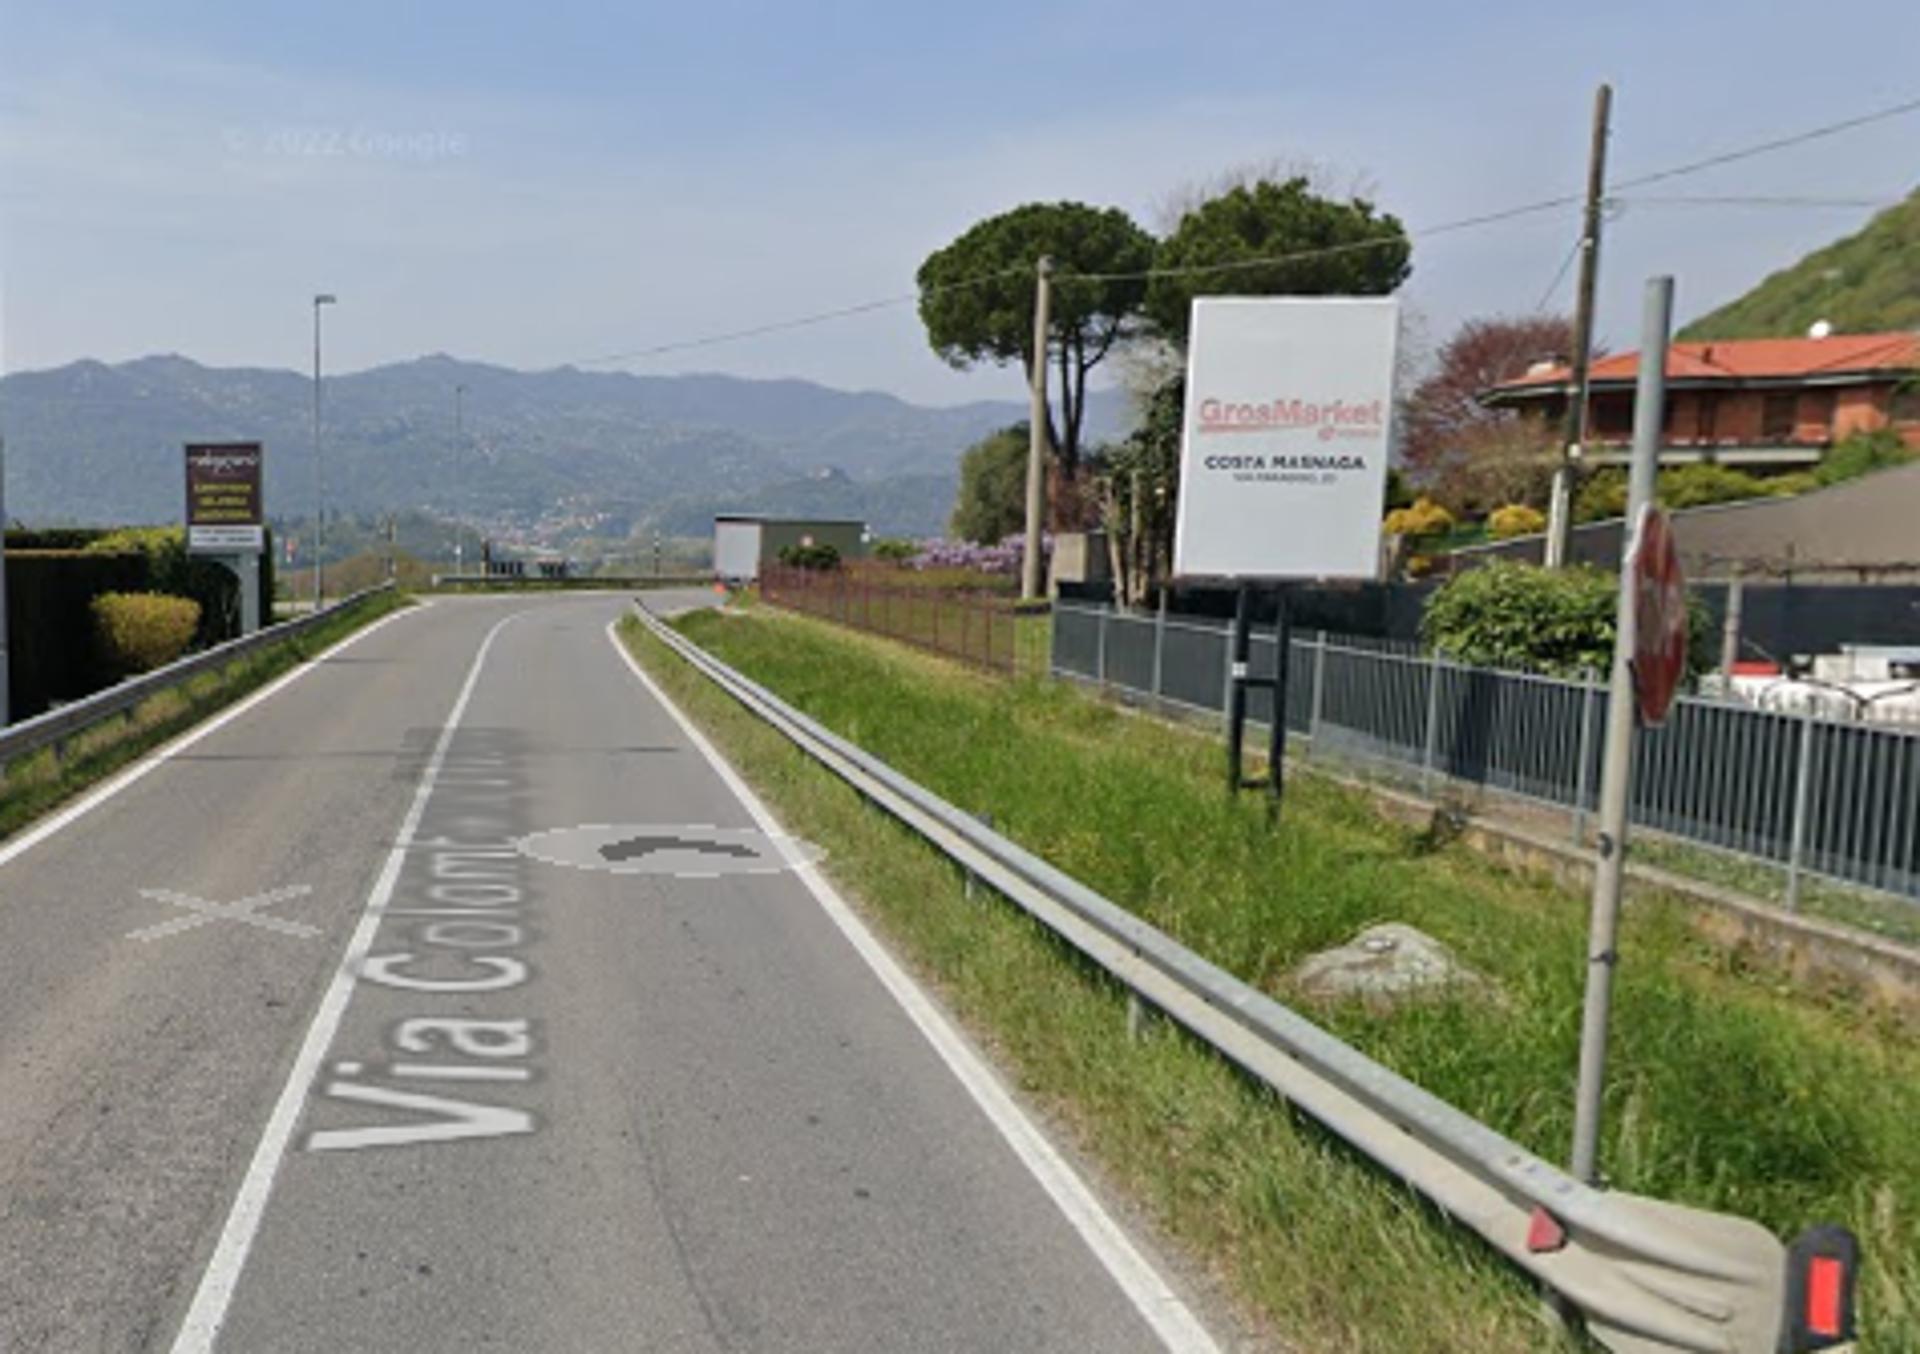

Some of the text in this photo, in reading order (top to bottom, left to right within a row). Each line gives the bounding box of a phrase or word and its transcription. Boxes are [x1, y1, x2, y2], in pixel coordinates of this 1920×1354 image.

[1200, 398, 1382, 425] GrosMarket
[1204, 455, 1367, 470] COSTA MASNAGA
